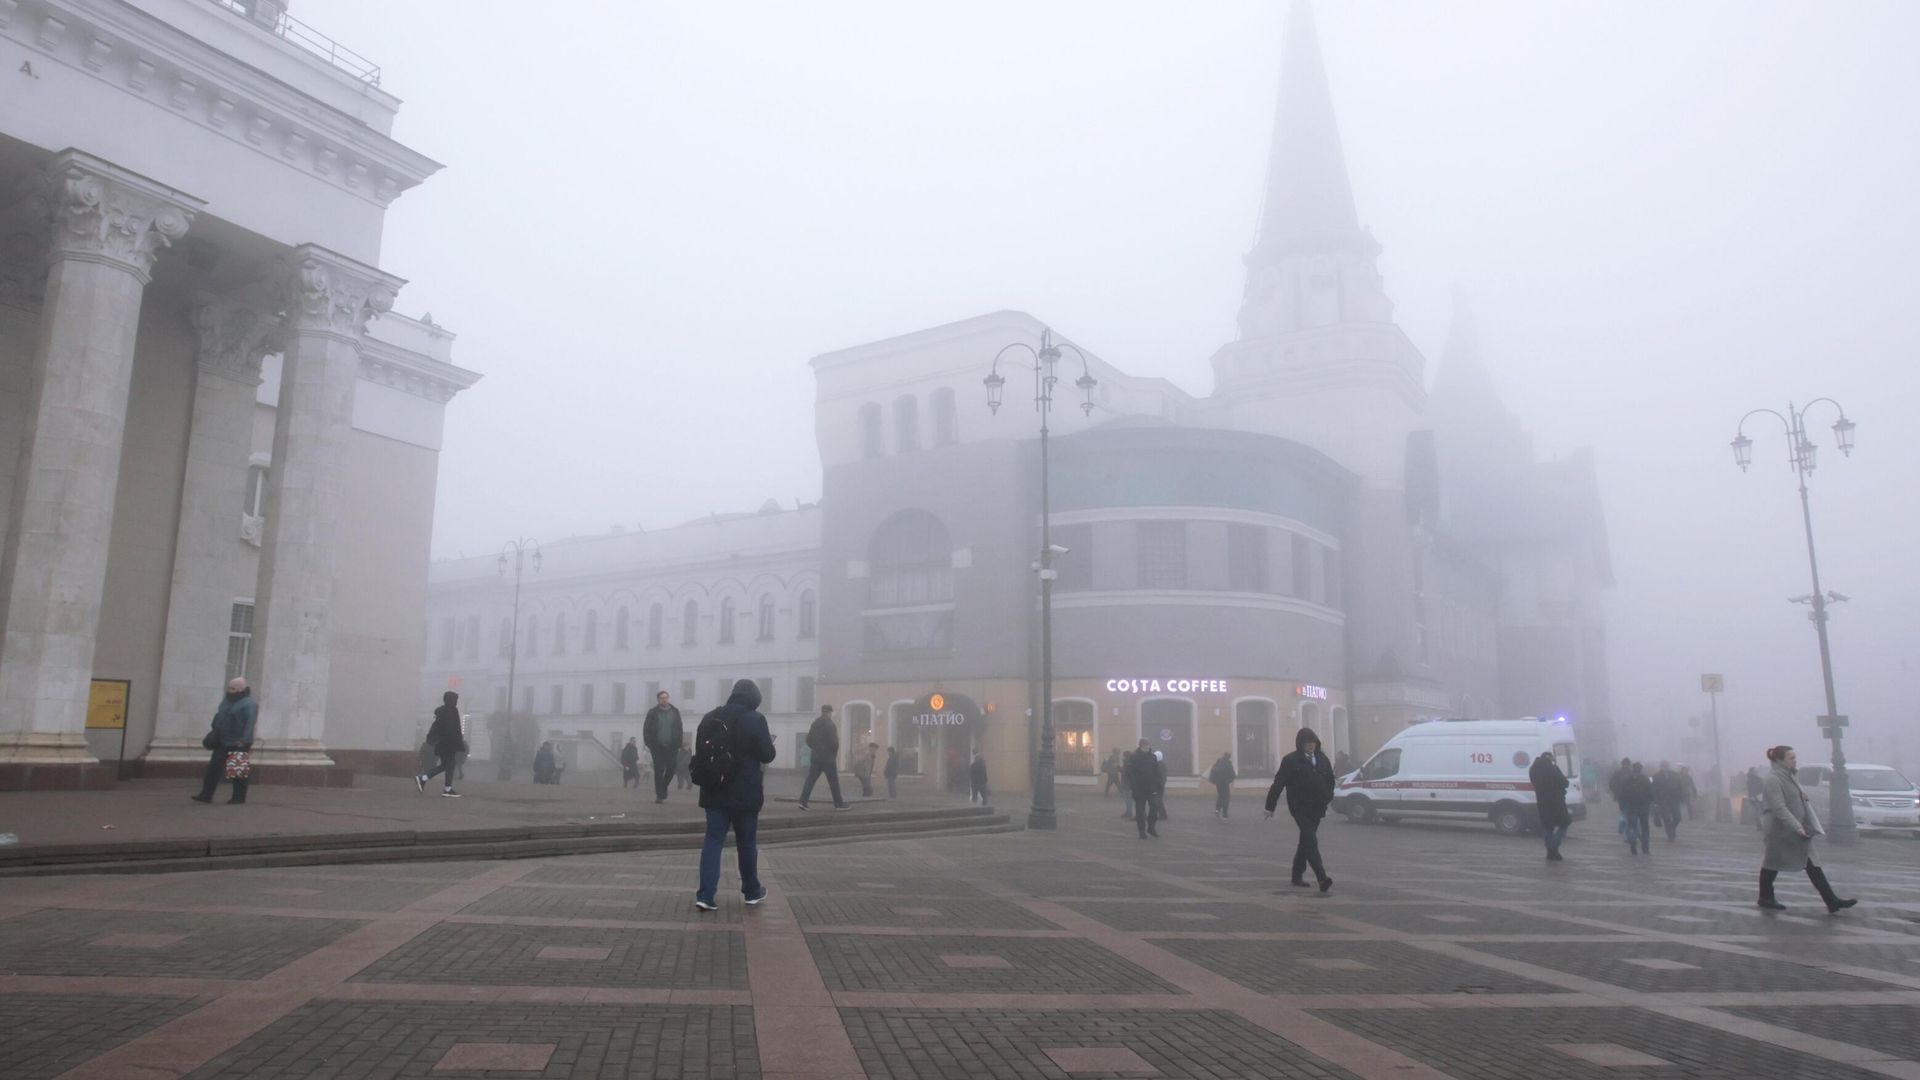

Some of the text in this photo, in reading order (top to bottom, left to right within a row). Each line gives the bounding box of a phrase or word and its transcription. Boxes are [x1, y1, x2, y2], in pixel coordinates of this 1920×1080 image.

[1106, 679, 1228, 694] COSTA COFFEE
[920, 712, 965, 726] ПАТИО
[1470, 752, 1493, 764] 103
